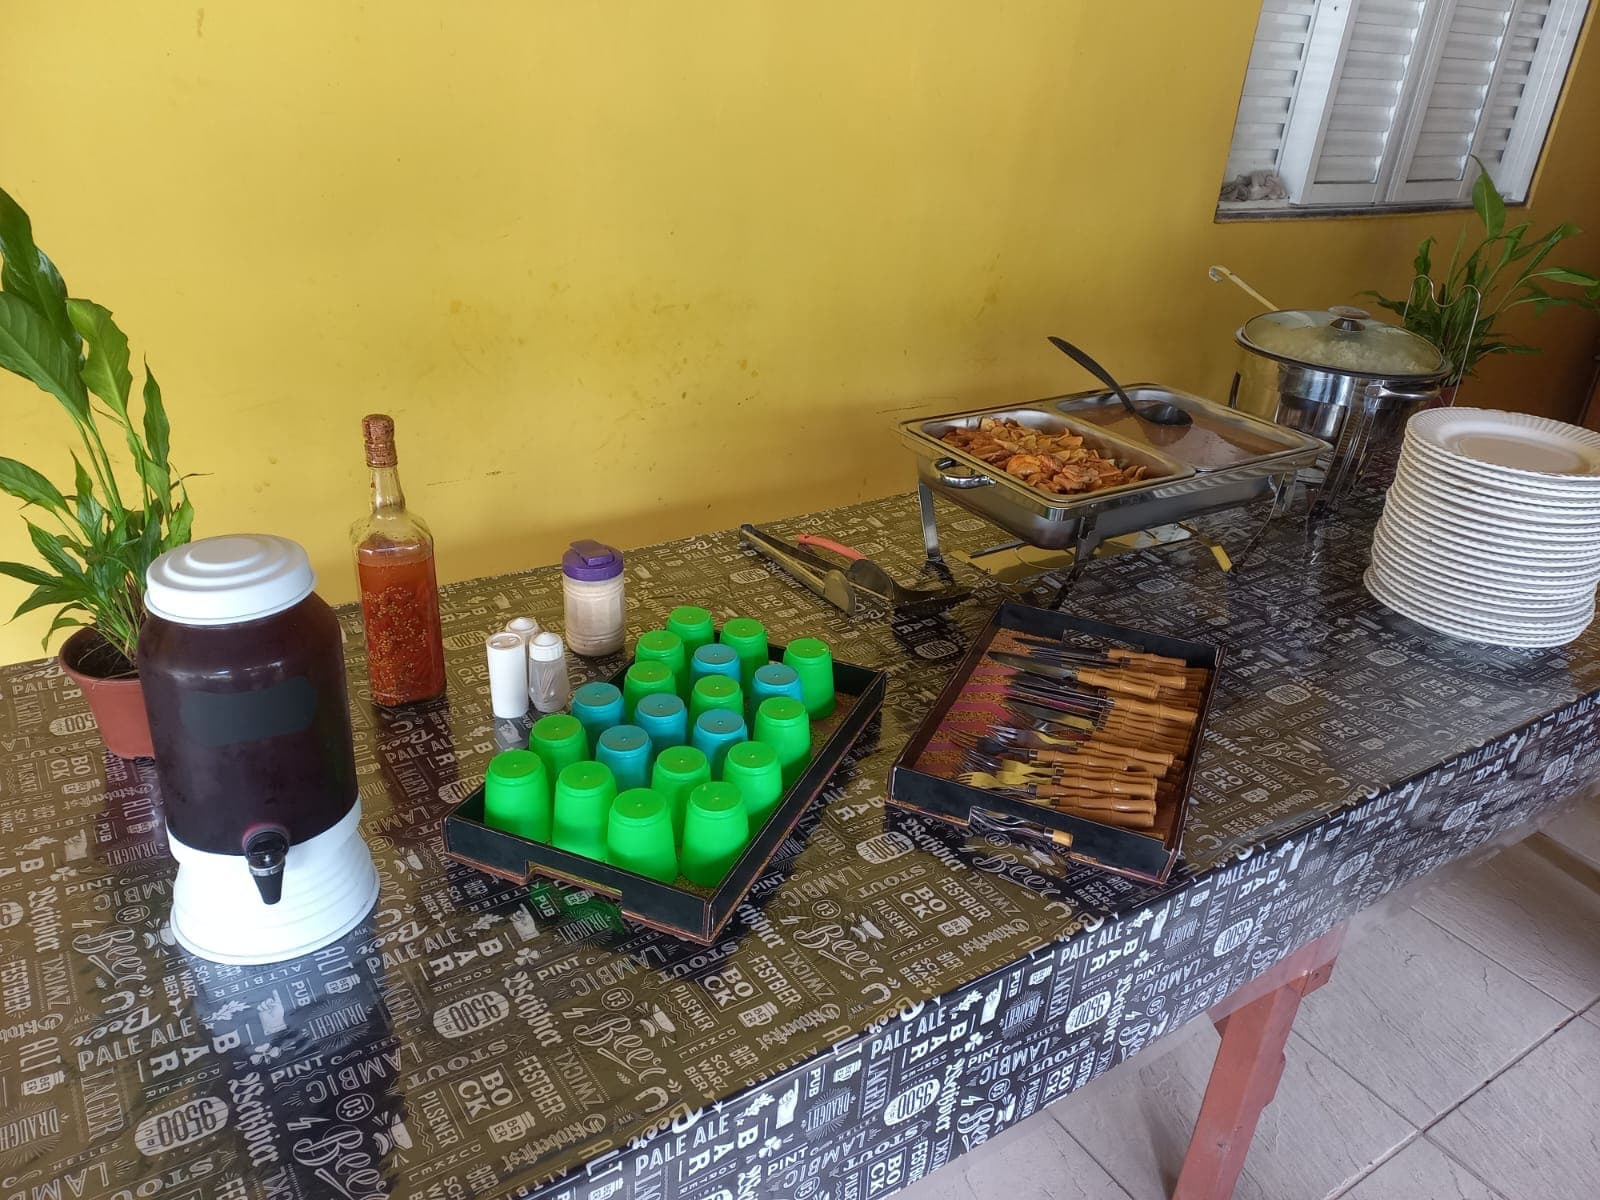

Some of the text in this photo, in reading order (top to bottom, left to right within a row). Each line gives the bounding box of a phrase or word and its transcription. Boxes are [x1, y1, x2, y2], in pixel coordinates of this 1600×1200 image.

[12, 680, 57, 695] PALE
[71, 755, 91, 774] BO
[385, 735, 460, 763] PALE ALE
[436, 741, 493, 766] BAR
[51, 759, 70, 779] CK
[834, 794, 890, 822] BAR
[846, 814, 887, 834] PORTER
[64, 874, 115, 898] PINT
[750, 873, 789, 896] PINT
[781, 866, 863, 909] LAMBIC
[856, 863, 927, 900] STOUT
[972, 845, 1058, 903] Beer
[899, 891, 932, 919] CK
[915, 885, 947, 914] BO
[939, 877, 992, 920] FESTBIER
[966, 871, 1018, 917] ZWICKL
[557, 913, 609, 945] DRAUGHT
[872, 899, 917, 939] PILSENER
[1049, 914, 1102, 947] Beer
[366, 926, 463, 974] PALE ALE
[429, 936, 503, 977] BAR
[656, 941, 740, 985] STOUT
[792, 915, 882, 984] Beer
[890, 935, 939, 962] DUNKEL
[920, 957, 943, 976] SCH
[936, 950, 963, 972] BIER
[44, 952, 69, 1010] ZWICKL
[434, 965, 490, 994] PORTER
[537, 954, 582, 983] PINT
[570, 946, 667, 998] LAMBIC
[721, 966, 754, 1001] BO
[750, 955, 802, 1006] FESTBIER
[781, 947, 832, 1001] ZWICKL
[899, 966, 924, 990] BIER
[910, 961, 941, 990] WARZ
[1004, 968, 1026, 1001] PUB
[291, 978, 310, 1010] PUB
[374, 970, 421, 1028] LAGER
[670, 984, 714, 1032] PILSENER
[703, 973, 736, 1008] CK
[70, 1006, 161, 1047] Beer
[308, 1002, 367, 1041] DRAUGHT
[860, 998, 924, 1038] Beer
[869, 1005, 950, 1060] PALE ALE
[1000, 995, 1042, 1032] DRAUGHT
[79, 1015, 195, 1073] PALE ALE
[151, 1029, 237, 1079] BAR
[573, 1005, 665, 1089] Beer
[678, 1026, 737, 1059] DUNKEL
[729, 1043, 758, 1070] BIER
[906, 1019, 968, 1066] BAR
[965, 1041, 1004, 1071] PINT
[146, 1064, 219, 1100] PORTER
[271, 1051, 325, 1087] PINT
[306, 1042, 422, 1107] LAMBIC
[406, 1037, 507, 1092] STOUT
[554, 1044, 603, 1112] ZWICKL
[683, 1065, 709, 1094] BIER
[698, 1057, 728, 1093] WARZ
[710, 1053, 733, 1076] SCH
[743, 1046, 818, 1089] ALTBIER
[804, 1065, 826, 1101] PUB
[899, 1051, 948, 1083] PORTER
[978, 1037, 1048, 1090] LAMBIC
[80, 1069, 122, 1140] LAGER
[458, 1077, 491, 1120] CK
[480, 1068, 512, 1111] BO
[517, 1054, 567, 1118] FESTBIER
[860, 1056, 892, 1118] LAGER
[417, 1089, 458, 1149] PILSENER
[626, 1104, 703, 1155] Beer
[804, 1092, 852, 1133] DRAUGHT
[408, 1141, 481, 1183] DUNKEL
[634, 1111, 733, 1176] PALE ALE
[685, 1124, 759, 1178] BAR
[765, 1143, 810, 1178] PINT
[781, 1131, 864, 1193] LAMBIC
[841, 1123, 920, 1174] STOUT
[468, 1163, 498, 1197] BIER
[864, 1159, 885, 1194] CK
[879, 1151, 902, 1187] BO
